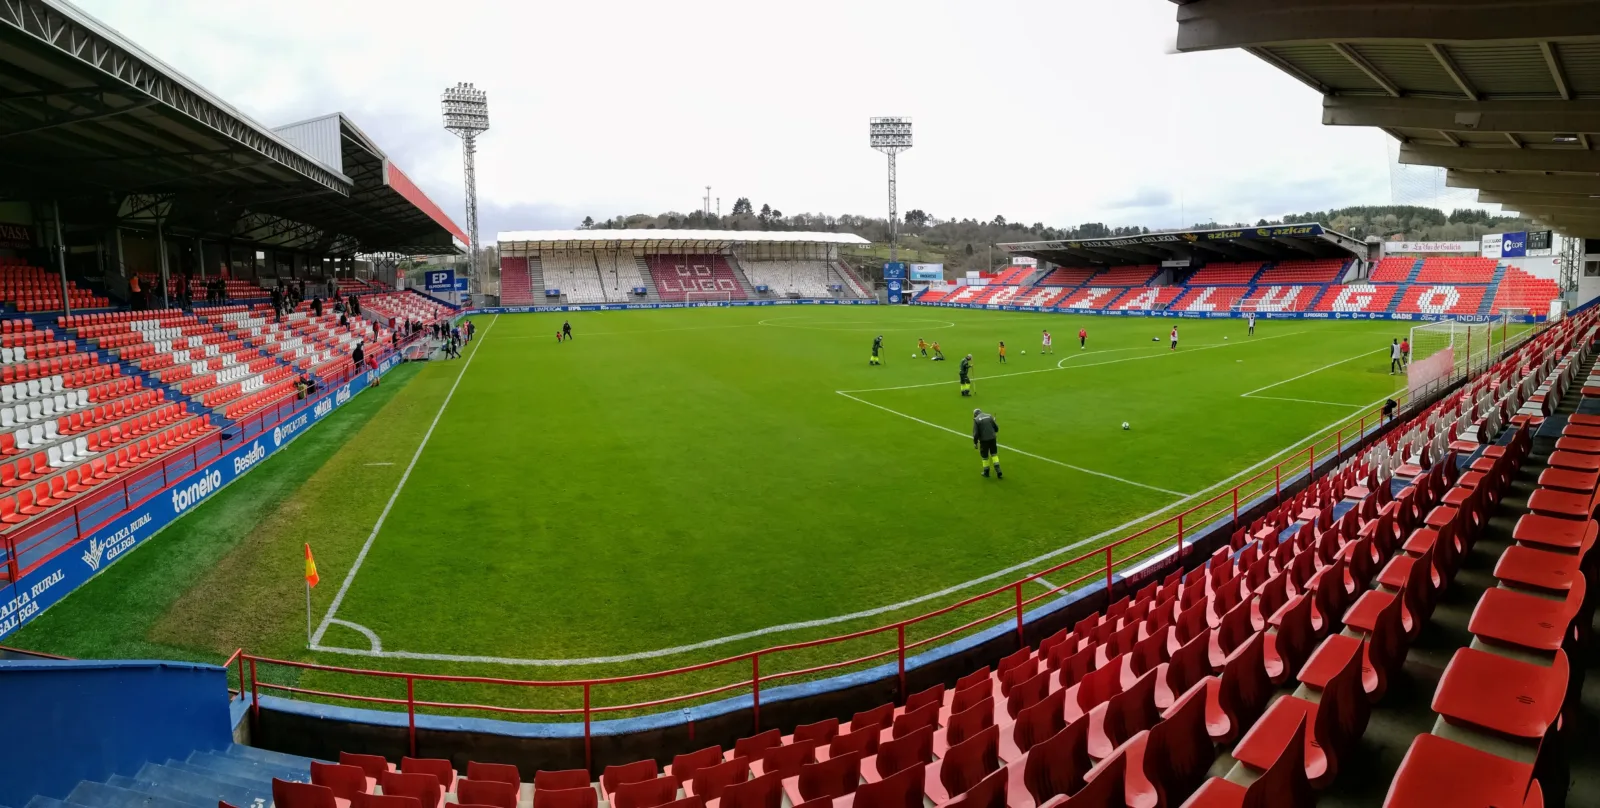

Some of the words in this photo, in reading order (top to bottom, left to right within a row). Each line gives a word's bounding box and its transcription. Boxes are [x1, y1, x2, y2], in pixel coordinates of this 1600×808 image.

[1082, 240, 1111, 248] CAIXA
[1109, 238, 1143, 247] RURAL
[1208, 230, 1243, 240] azkar
[1273, 226, 1313, 236] azkar
[432, 272, 448, 284] EP
[662, 278, 737, 291] LUGO
[1186, 284, 1460, 313] LUGO
[234, 439, 265, 475] Besteiro
[171, 468, 222, 513] torneiro
[105, 526, 130, 549] CAIXA
[130, 513, 152, 533] RURAL
[106, 534, 136, 560] GALEGA
[31, 568, 65, 598] RURAL
